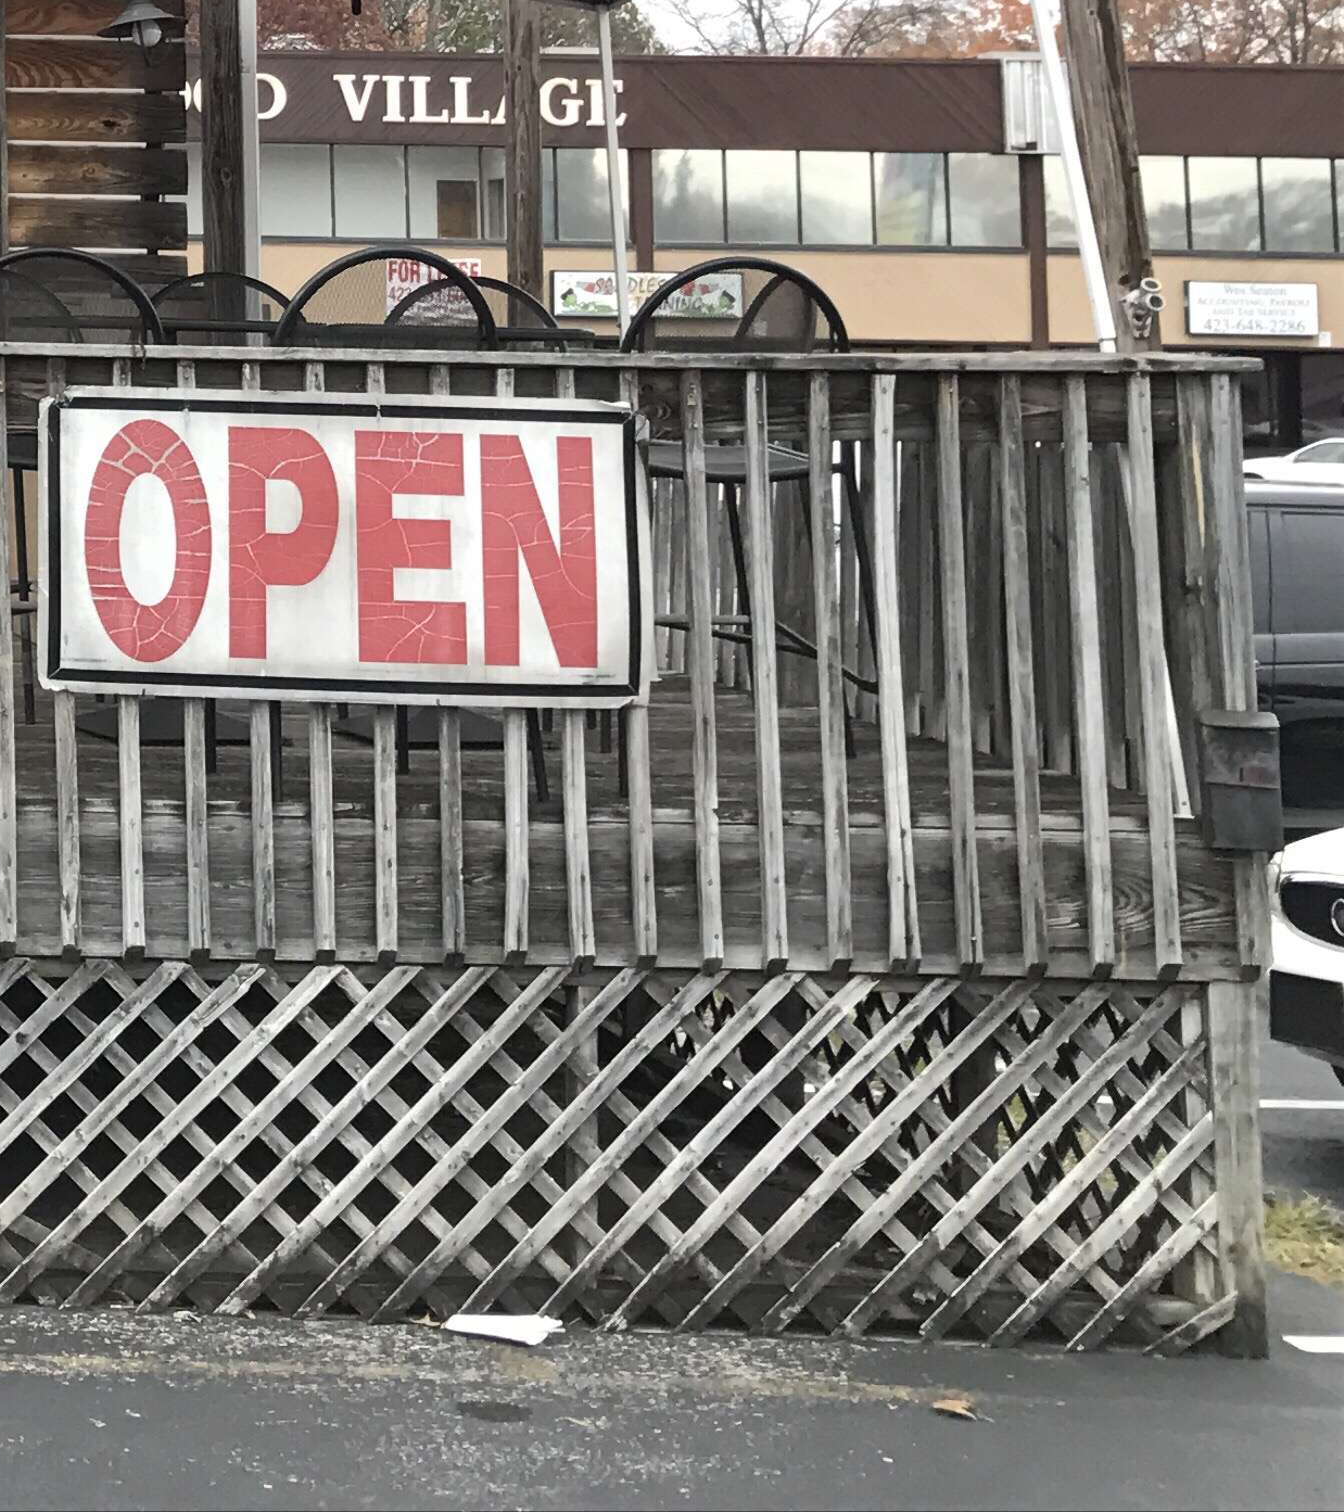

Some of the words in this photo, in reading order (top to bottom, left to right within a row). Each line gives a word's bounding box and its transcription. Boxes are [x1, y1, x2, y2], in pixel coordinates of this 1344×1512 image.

[333, 73, 628, 126] VILLGE
[388, 258, 421, 283] FOR
[84, 419, 599, 668] OPEN
